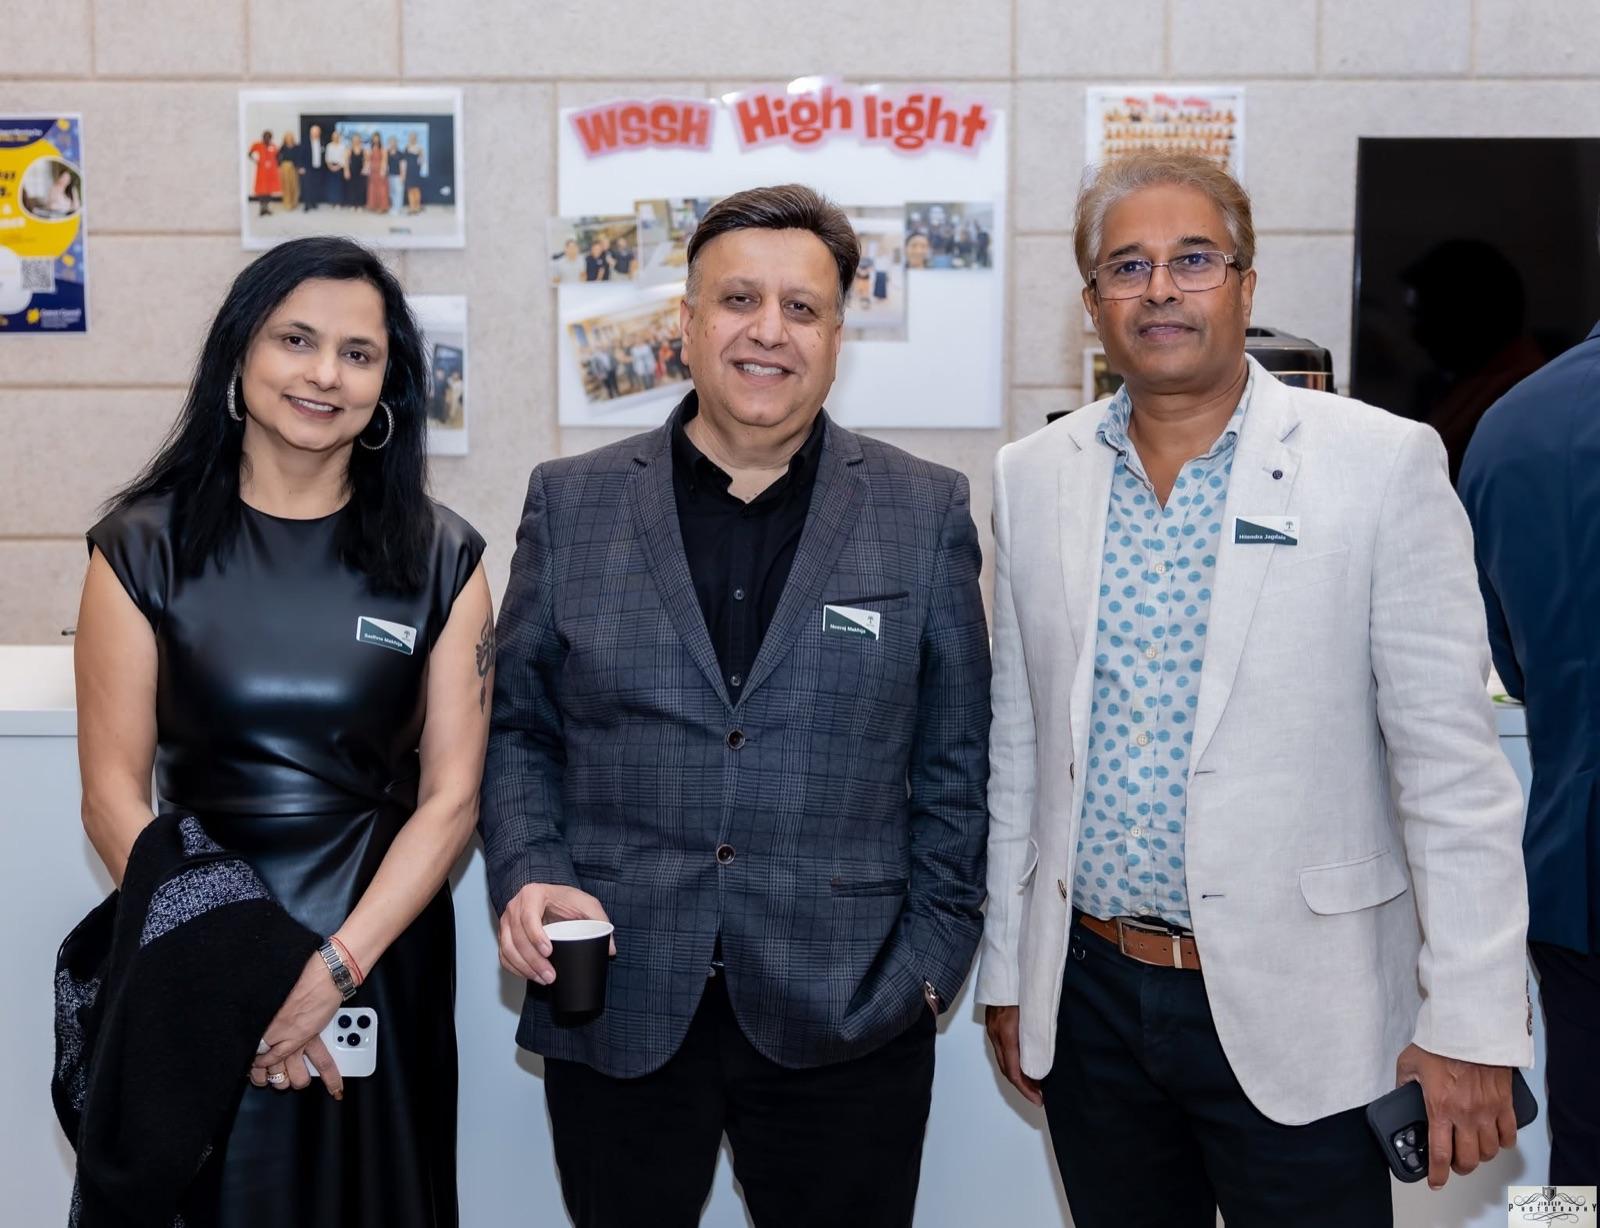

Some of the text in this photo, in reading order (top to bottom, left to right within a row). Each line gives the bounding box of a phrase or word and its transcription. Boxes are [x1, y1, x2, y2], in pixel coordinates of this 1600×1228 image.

[576, 85, 986, 153] WSSH High light
